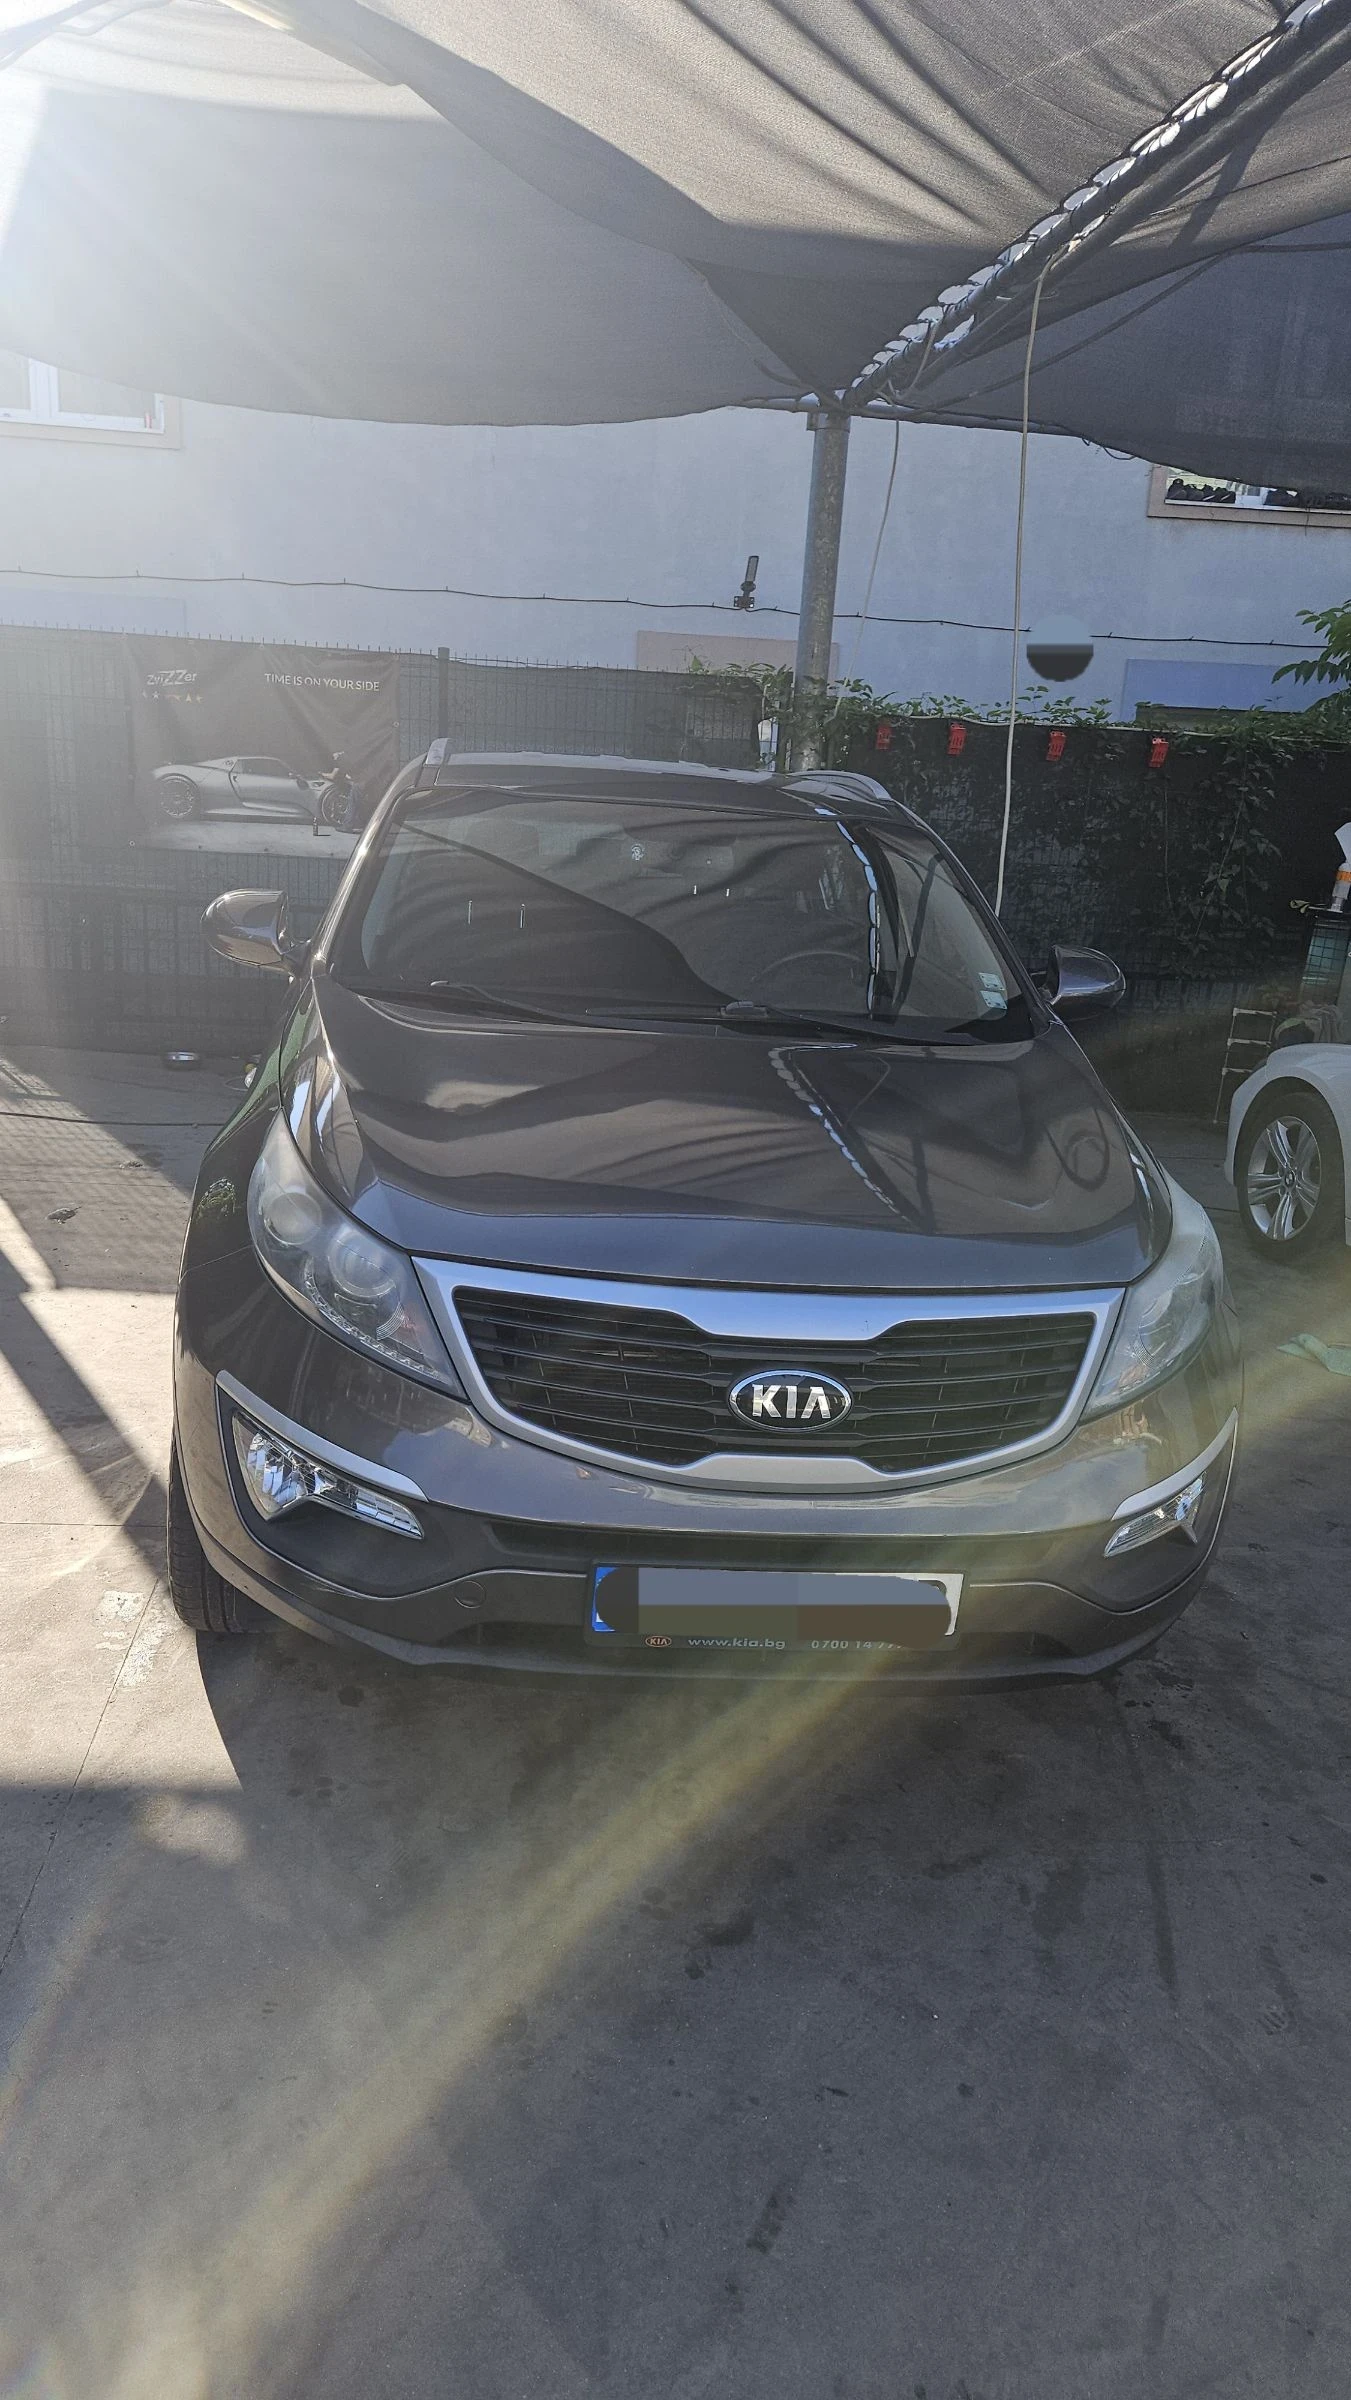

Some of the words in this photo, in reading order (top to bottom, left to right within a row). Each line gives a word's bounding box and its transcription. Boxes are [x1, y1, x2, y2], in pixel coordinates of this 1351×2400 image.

[264, 673, 291, 685] TIME
[293, 676, 303, 686] IS
[304, 677, 321, 686] ON
[323, 678, 354, 690] YOUR
[355, 680, 380, 692] SIDE
[752, 1384, 831, 1419] KIA
[649, 1637, 668, 1645] KIA
[688, 1638, 786, 1650] www.kia.bg
[811, 1640, 849, 1649] 0700
[855, 1640, 873, 1649] 14
